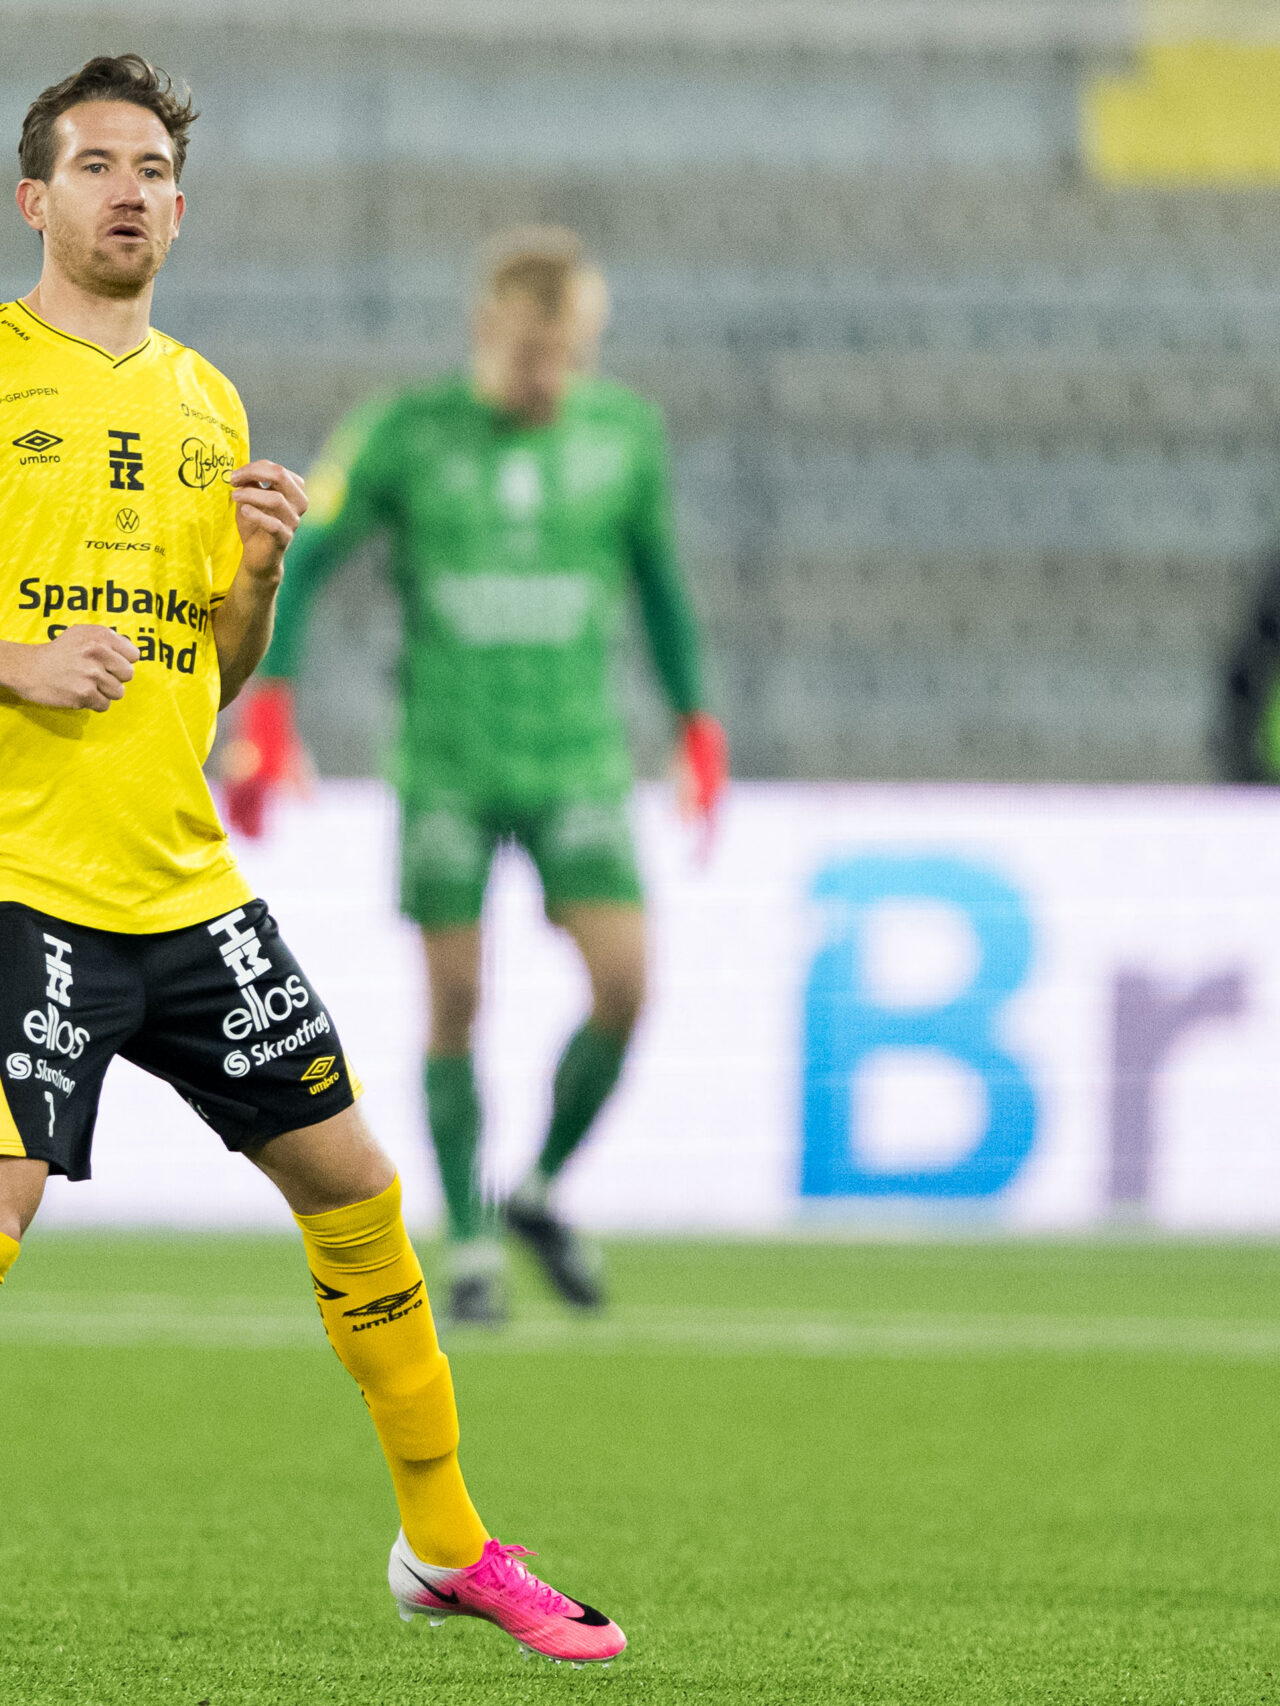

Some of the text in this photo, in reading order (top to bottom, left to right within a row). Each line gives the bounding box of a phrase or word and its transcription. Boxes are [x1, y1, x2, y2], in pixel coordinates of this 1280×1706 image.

[19, 454, 61, 466] umbro
[85, 540, 151, 552] TOVEKS
[18, 577, 208, 636] Sparbanken
[222, 974, 310, 1041] ellos
[23, 1002, 91, 1060] ellos
[308, 1071, 340, 1096] umbro
[351, 1298, 423, 1333] umbro
